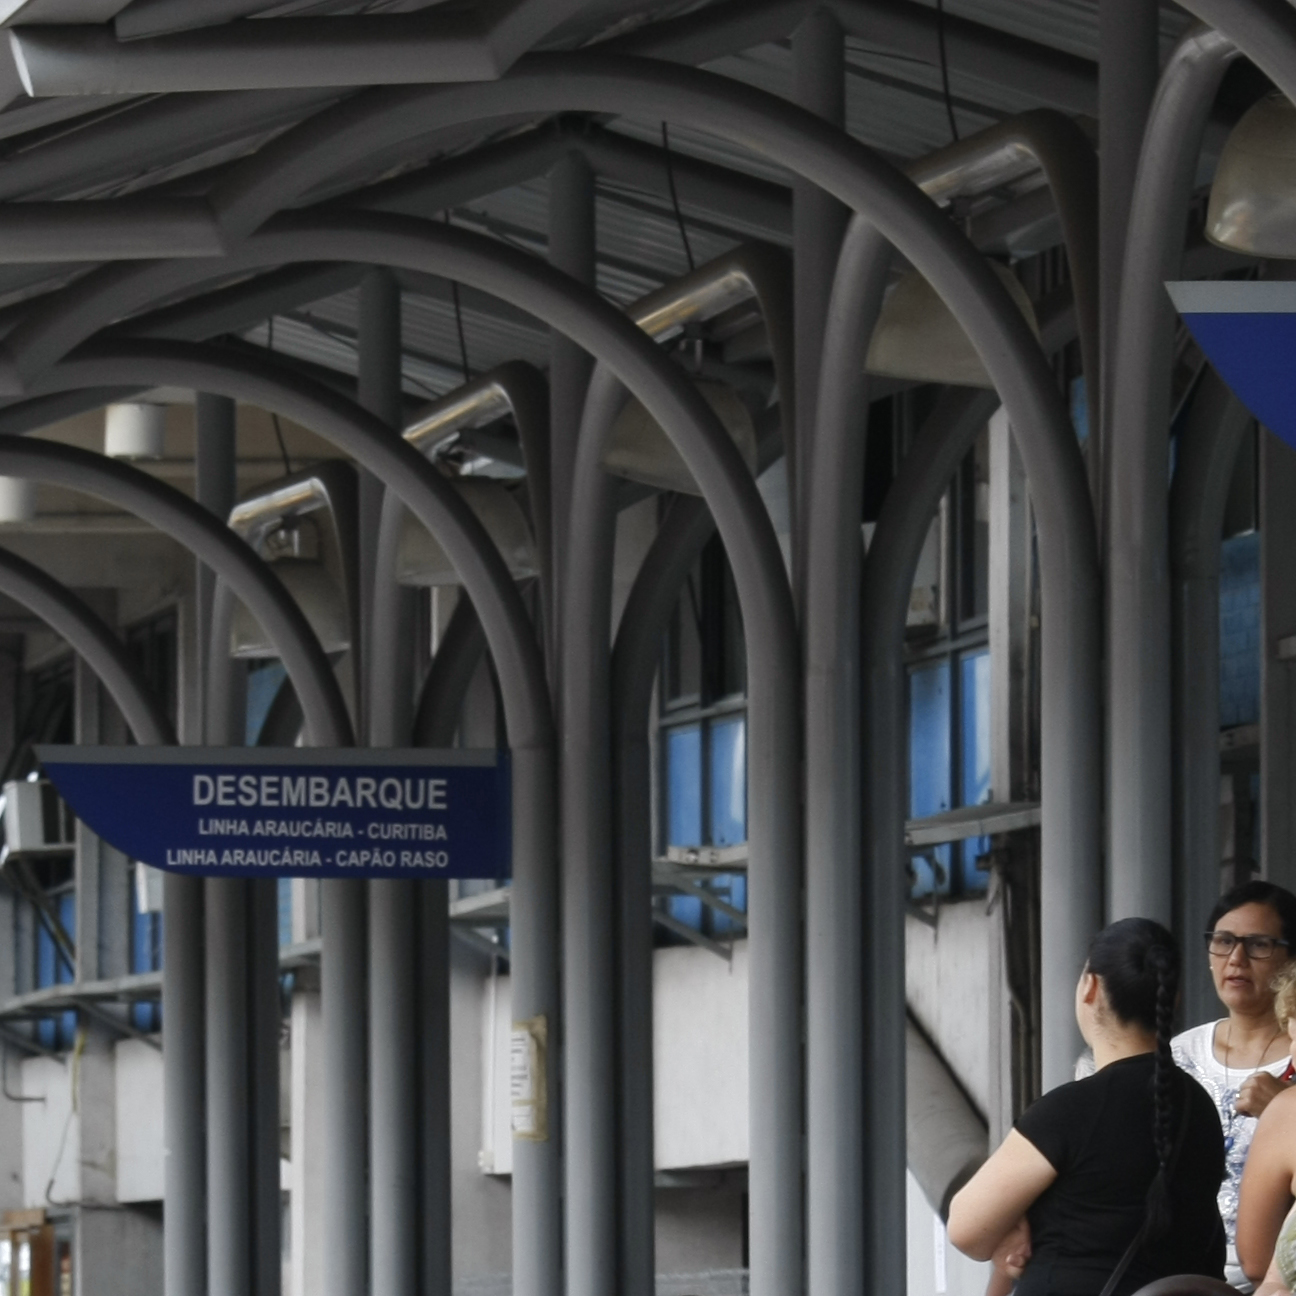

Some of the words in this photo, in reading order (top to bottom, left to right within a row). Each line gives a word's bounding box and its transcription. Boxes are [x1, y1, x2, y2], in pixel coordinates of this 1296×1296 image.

[193, 775, 447, 811] DESEMBARQUE
[198, 818, 249, 836] LINHA
[252, 815, 353, 838] ARAUCÁRIA
[367, 822, 447, 841] CURITIBA
[166, 848, 218, 866] LINHA
[220, 845, 322, 868] ARAUCÁRIA
[336, 847, 396, 869] CAPÃO
[400, 851, 448, 869] RASO
